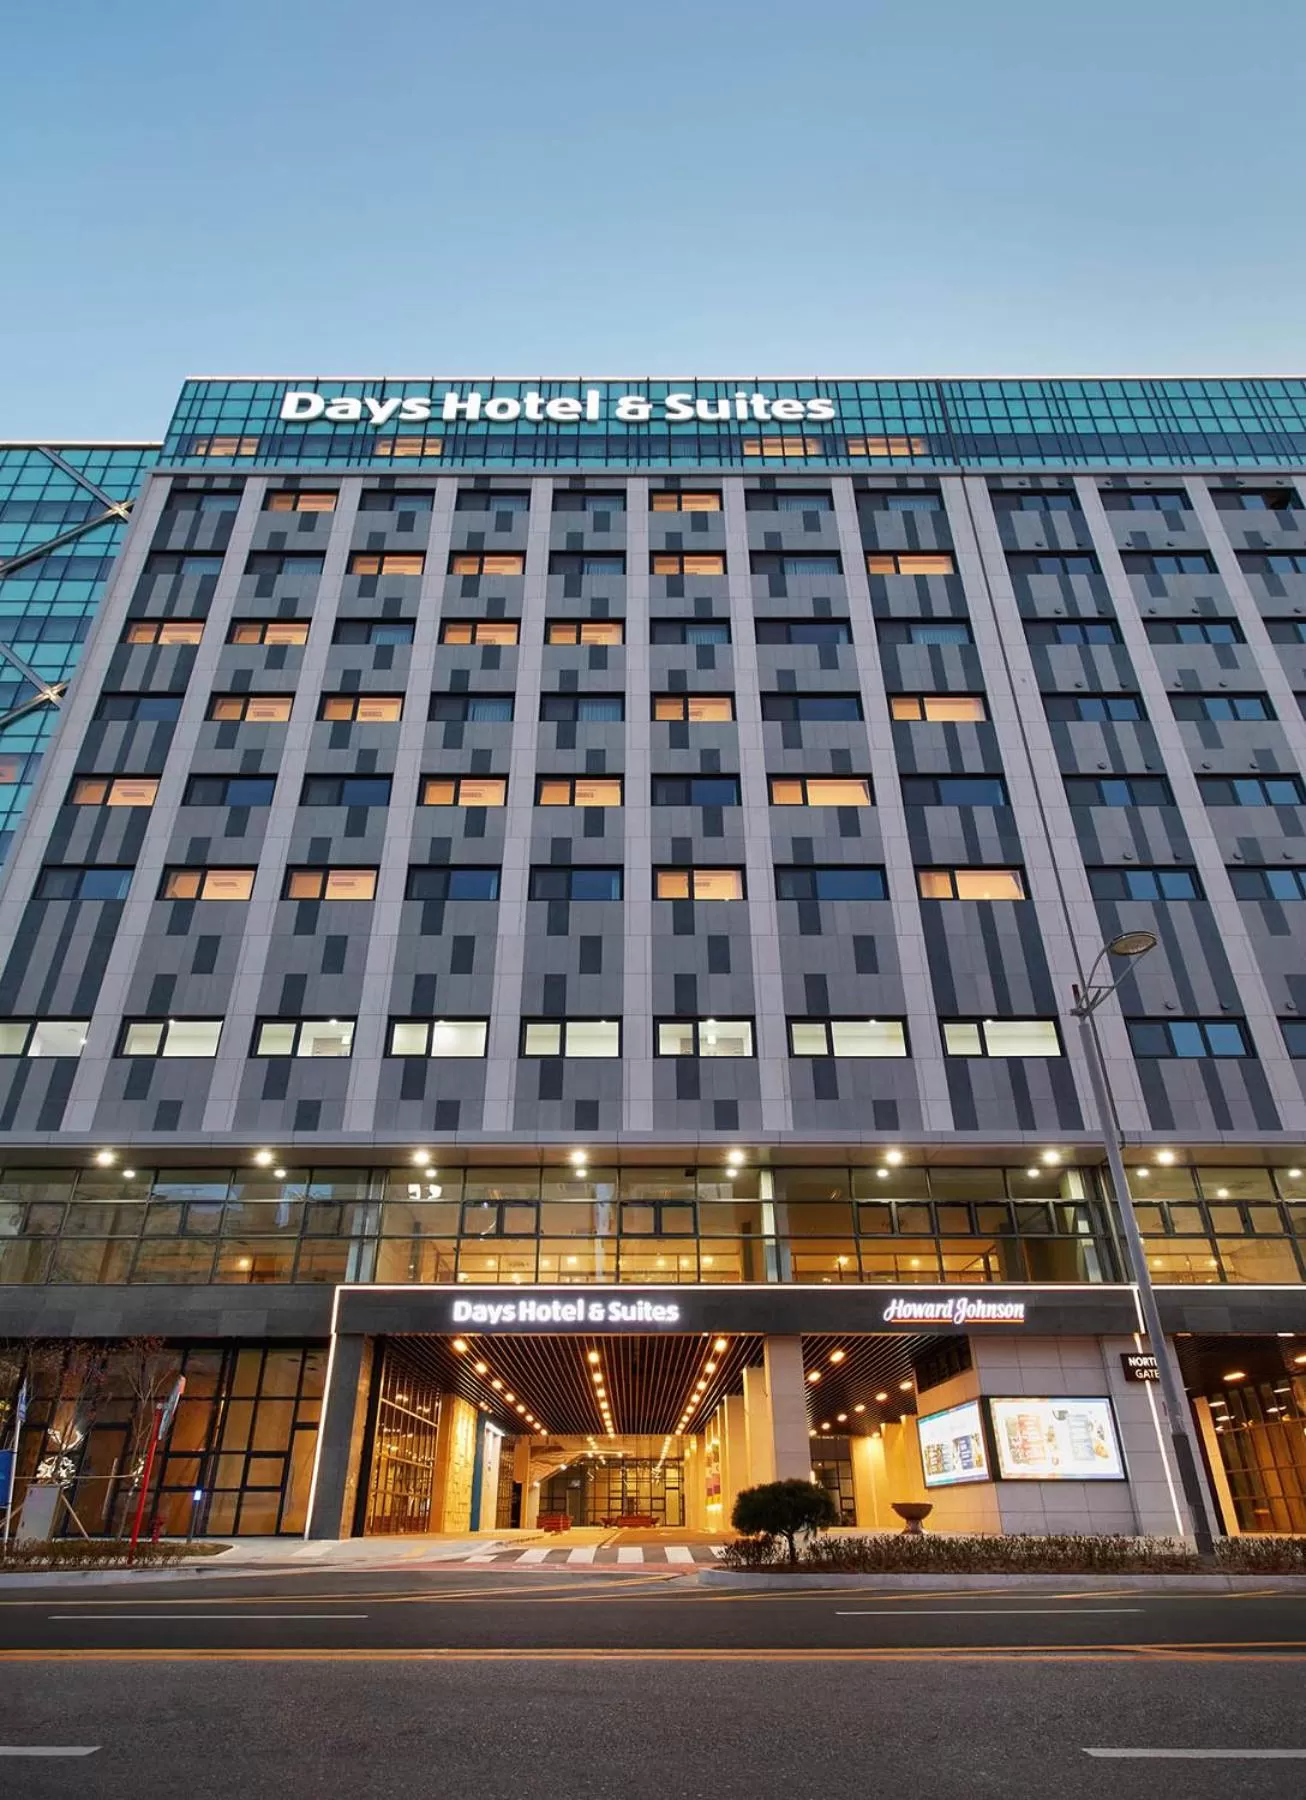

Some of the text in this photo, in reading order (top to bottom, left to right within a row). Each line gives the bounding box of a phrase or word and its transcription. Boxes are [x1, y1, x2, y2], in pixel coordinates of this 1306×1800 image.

[280, 389, 836, 426] Days Hotel & Suites
[452, 1298, 680, 1325] Days Hotel & Suites
[883, 1296, 1025, 1325] Howard Johnson
[1135, 1368, 1160, 1379] GATE
